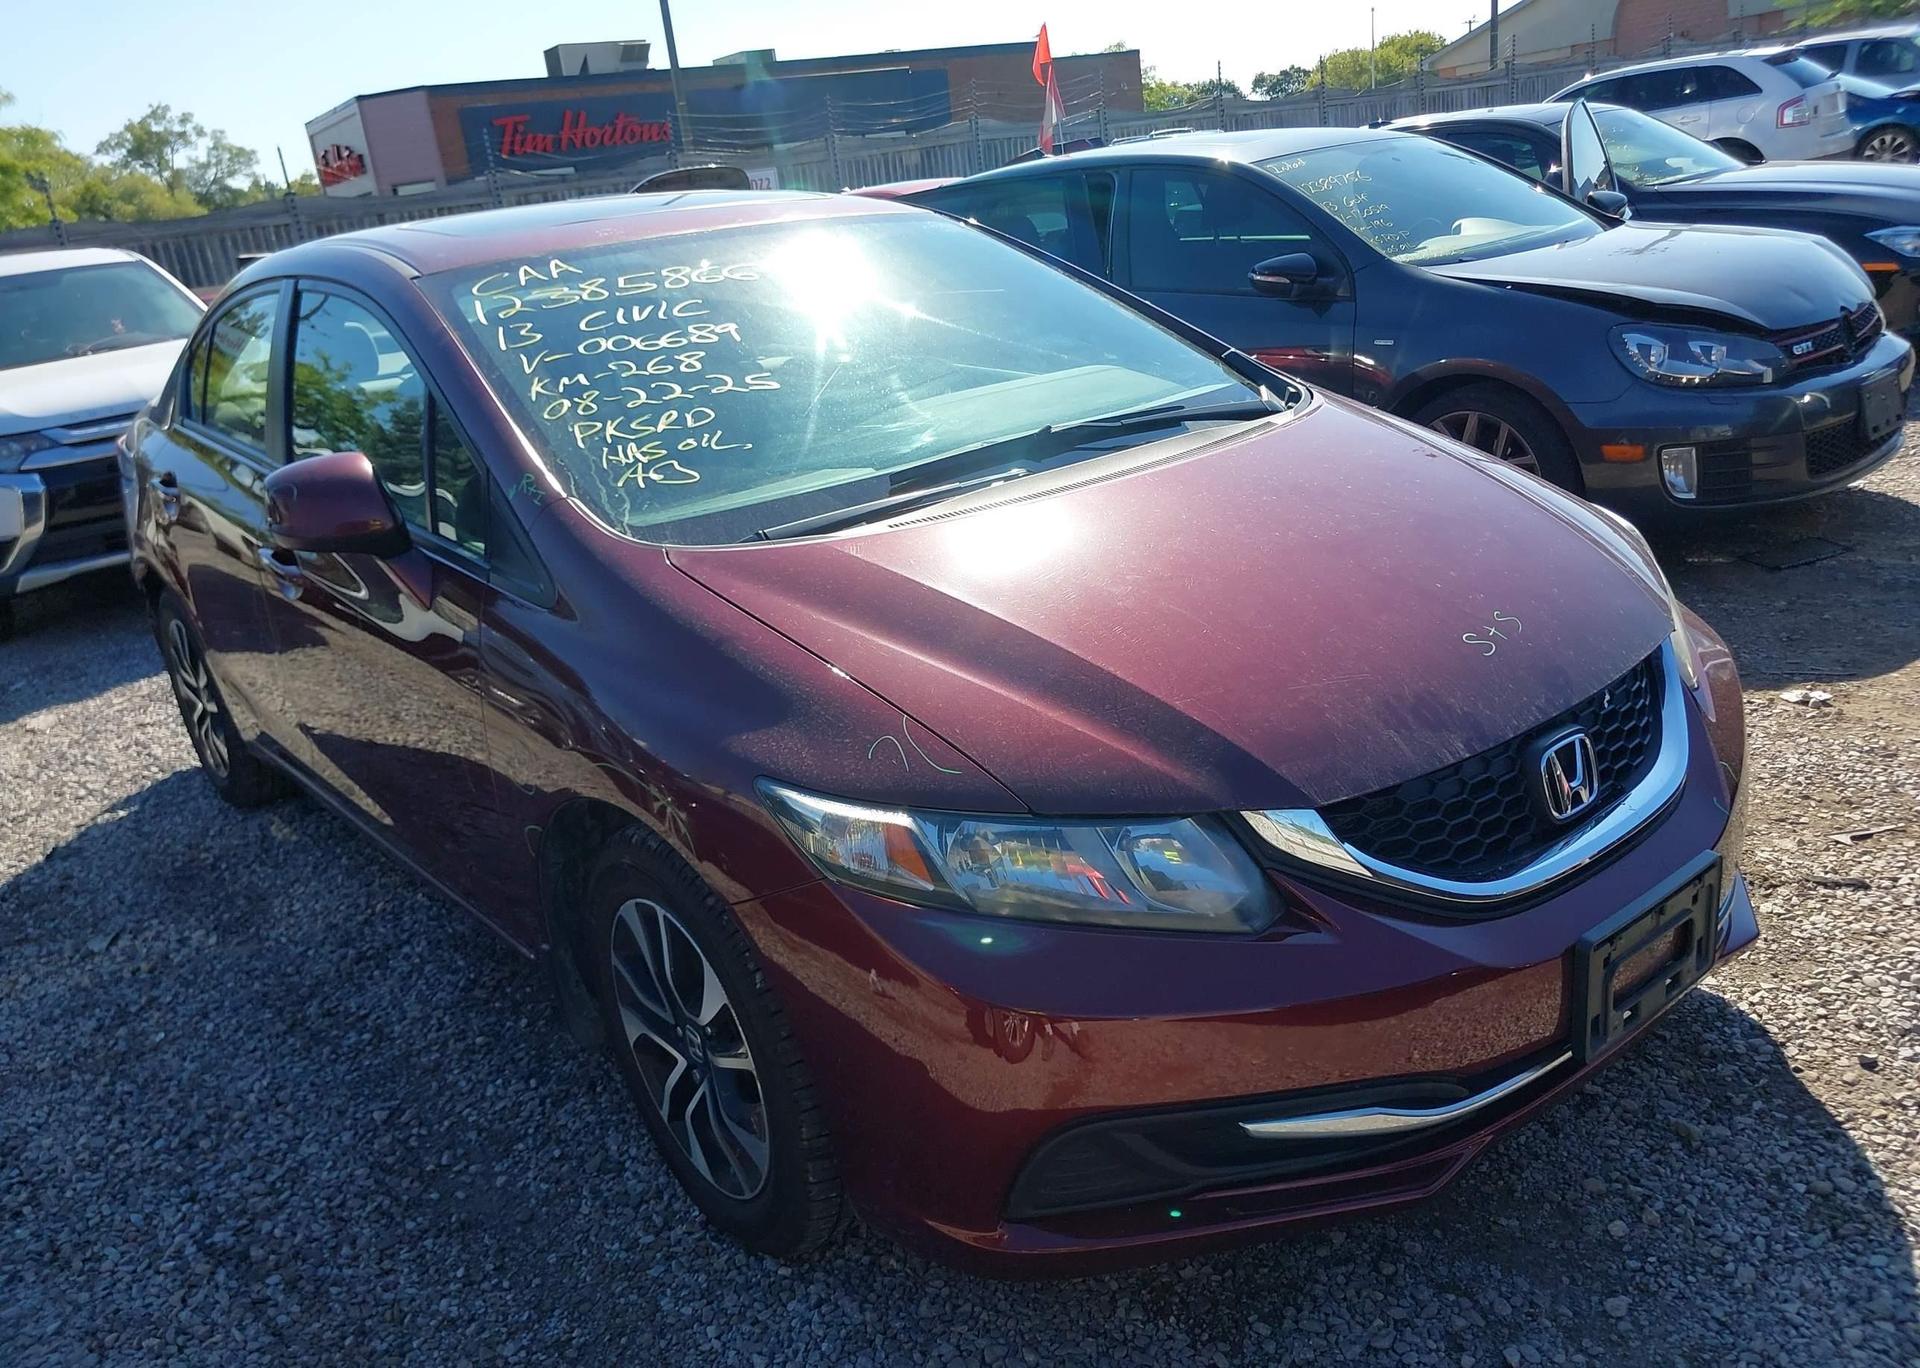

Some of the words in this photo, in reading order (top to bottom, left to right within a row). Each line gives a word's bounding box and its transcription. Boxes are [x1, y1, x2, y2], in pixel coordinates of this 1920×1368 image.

[493, 115, 552, 158] Tim
[560, 109, 672, 151] Hortons
[472, 259, 583, 297] CAA
[497, 323, 543, 351] 13
[579, 300, 710, 331] CIVIC
[1792, 341, 1812, 355] GTI
[543, 373, 781, 420] 08-22-25
[602, 442, 668, 469] HAS
